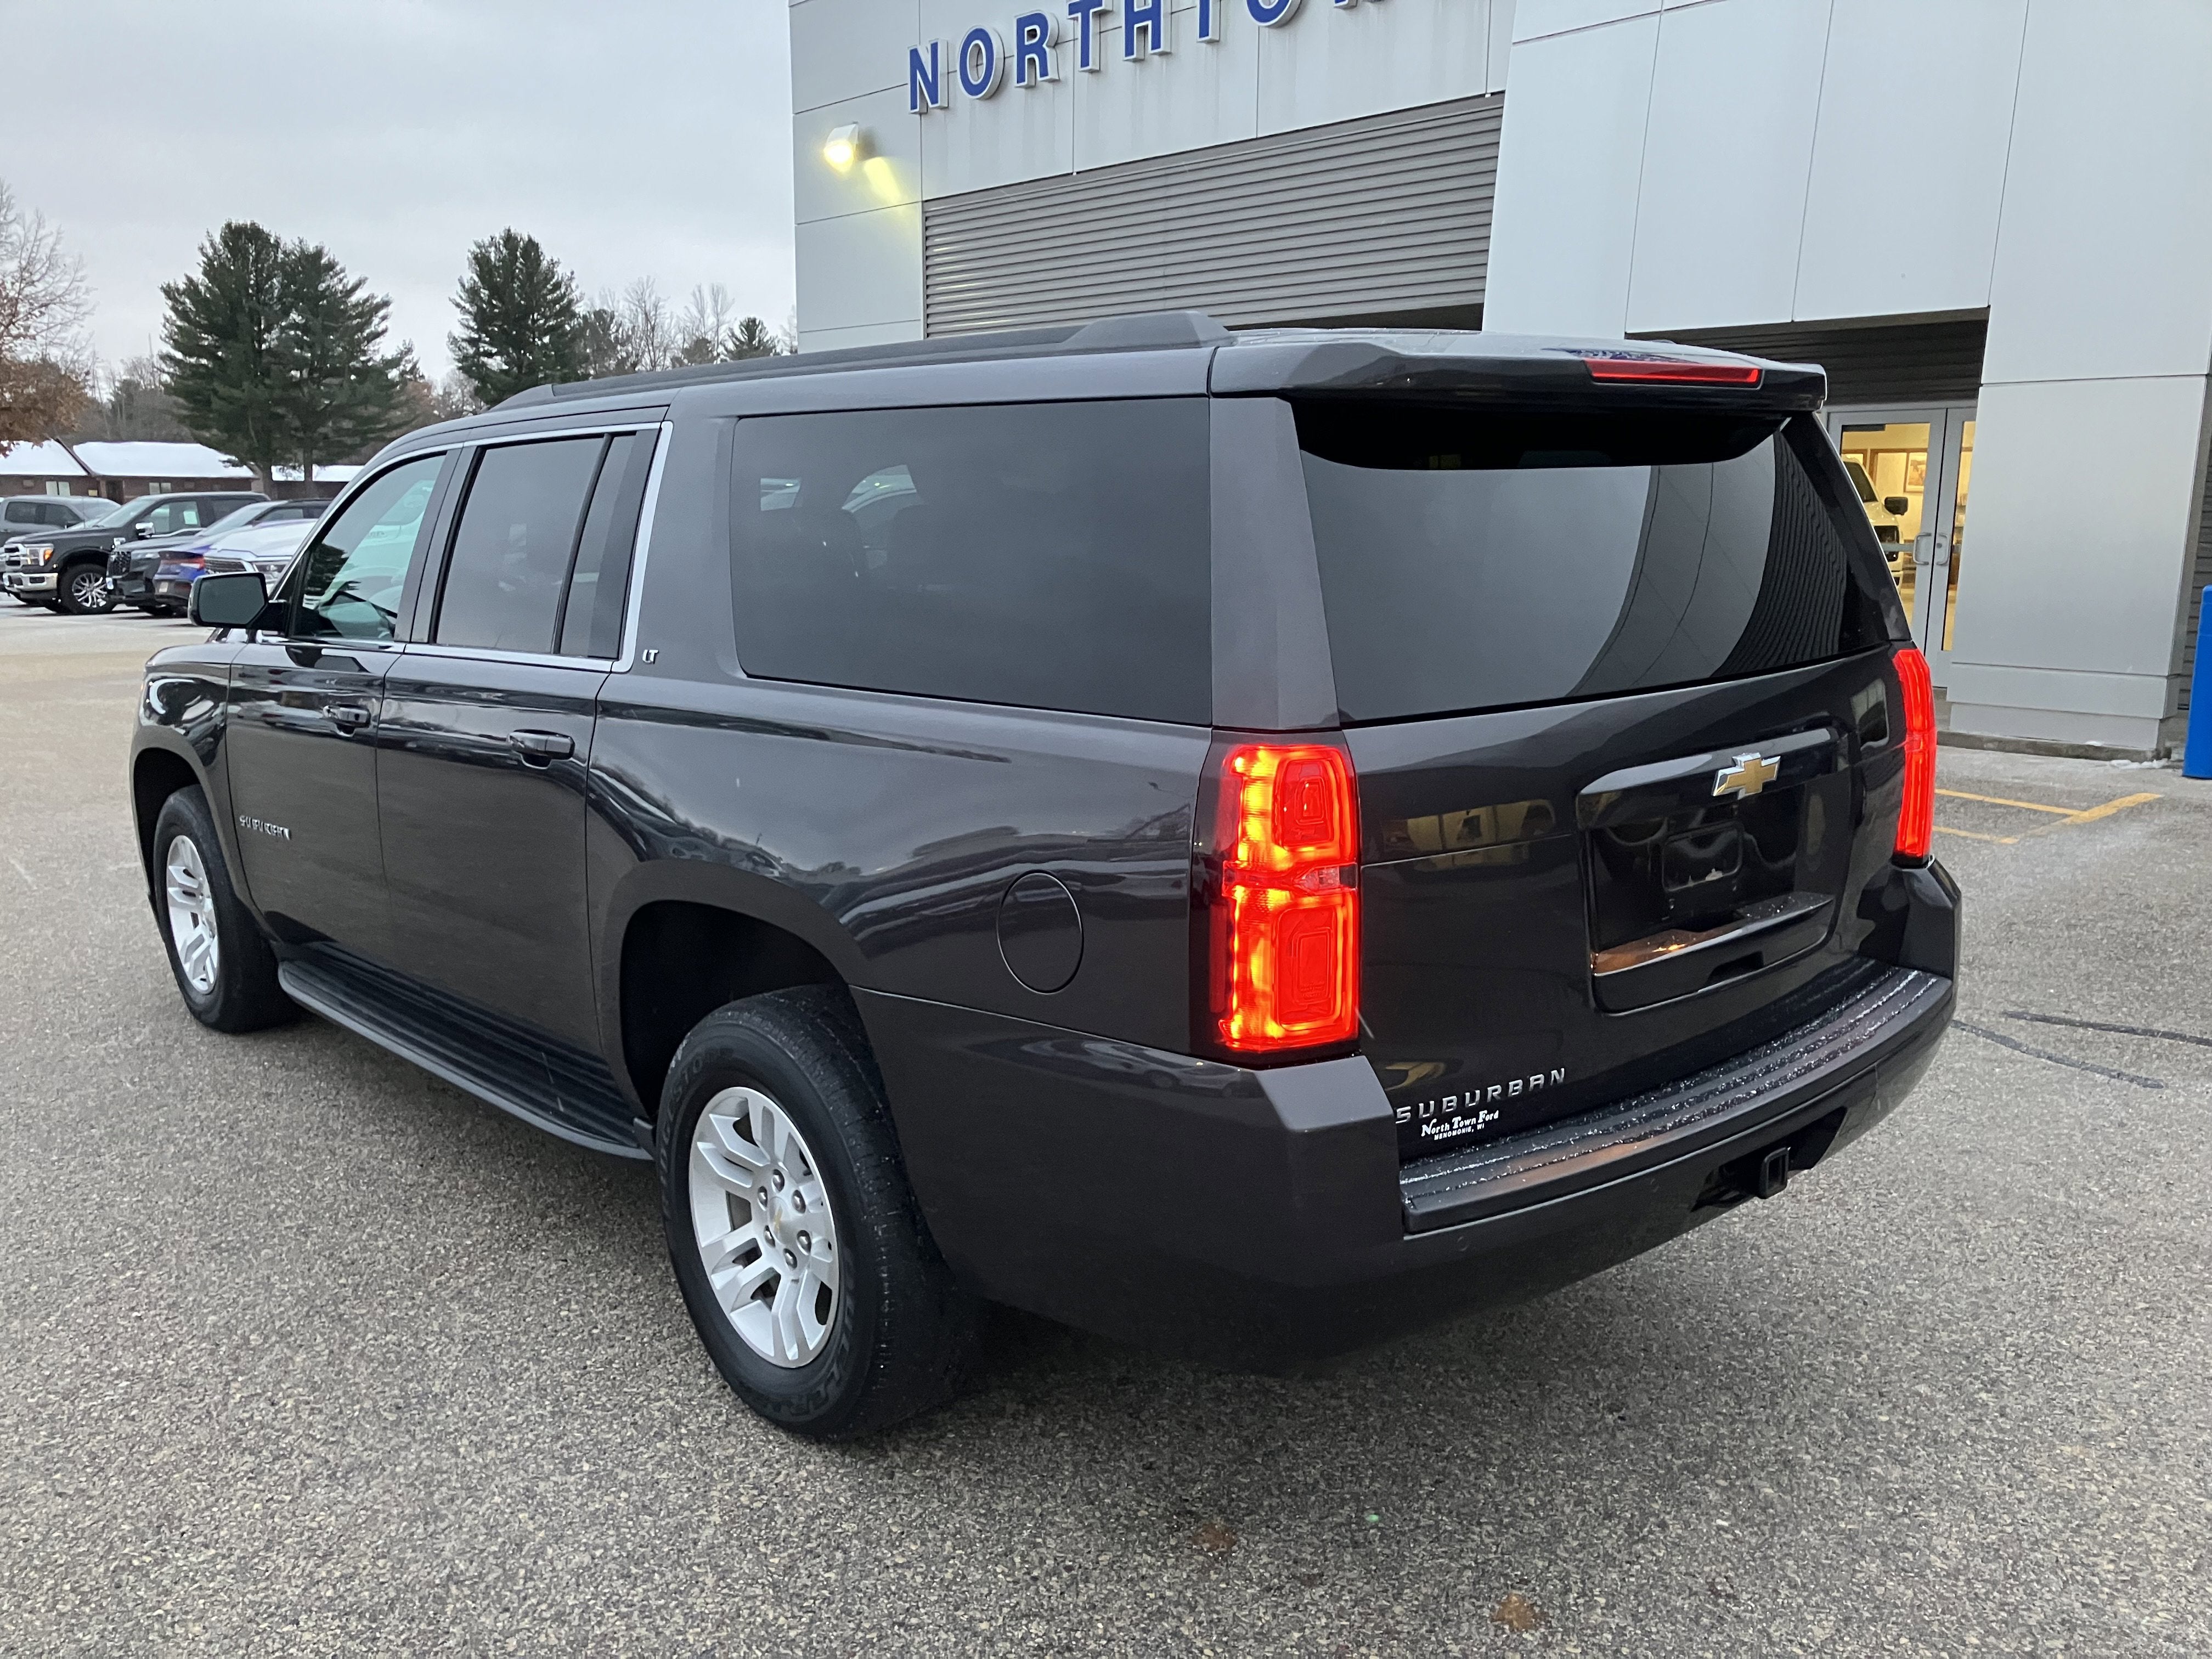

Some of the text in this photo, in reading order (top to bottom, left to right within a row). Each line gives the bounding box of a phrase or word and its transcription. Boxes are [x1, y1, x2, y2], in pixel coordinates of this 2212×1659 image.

[907, 0, 1357, 114] NORTH
[642, 648, 659, 664] LT
[1395, 1067, 1566, 1124] SUBURBAN
[1421, 1109, 1499, 1137] North Town Ford
[1434, 1126, 1474, 1141] MENOMONIE,
